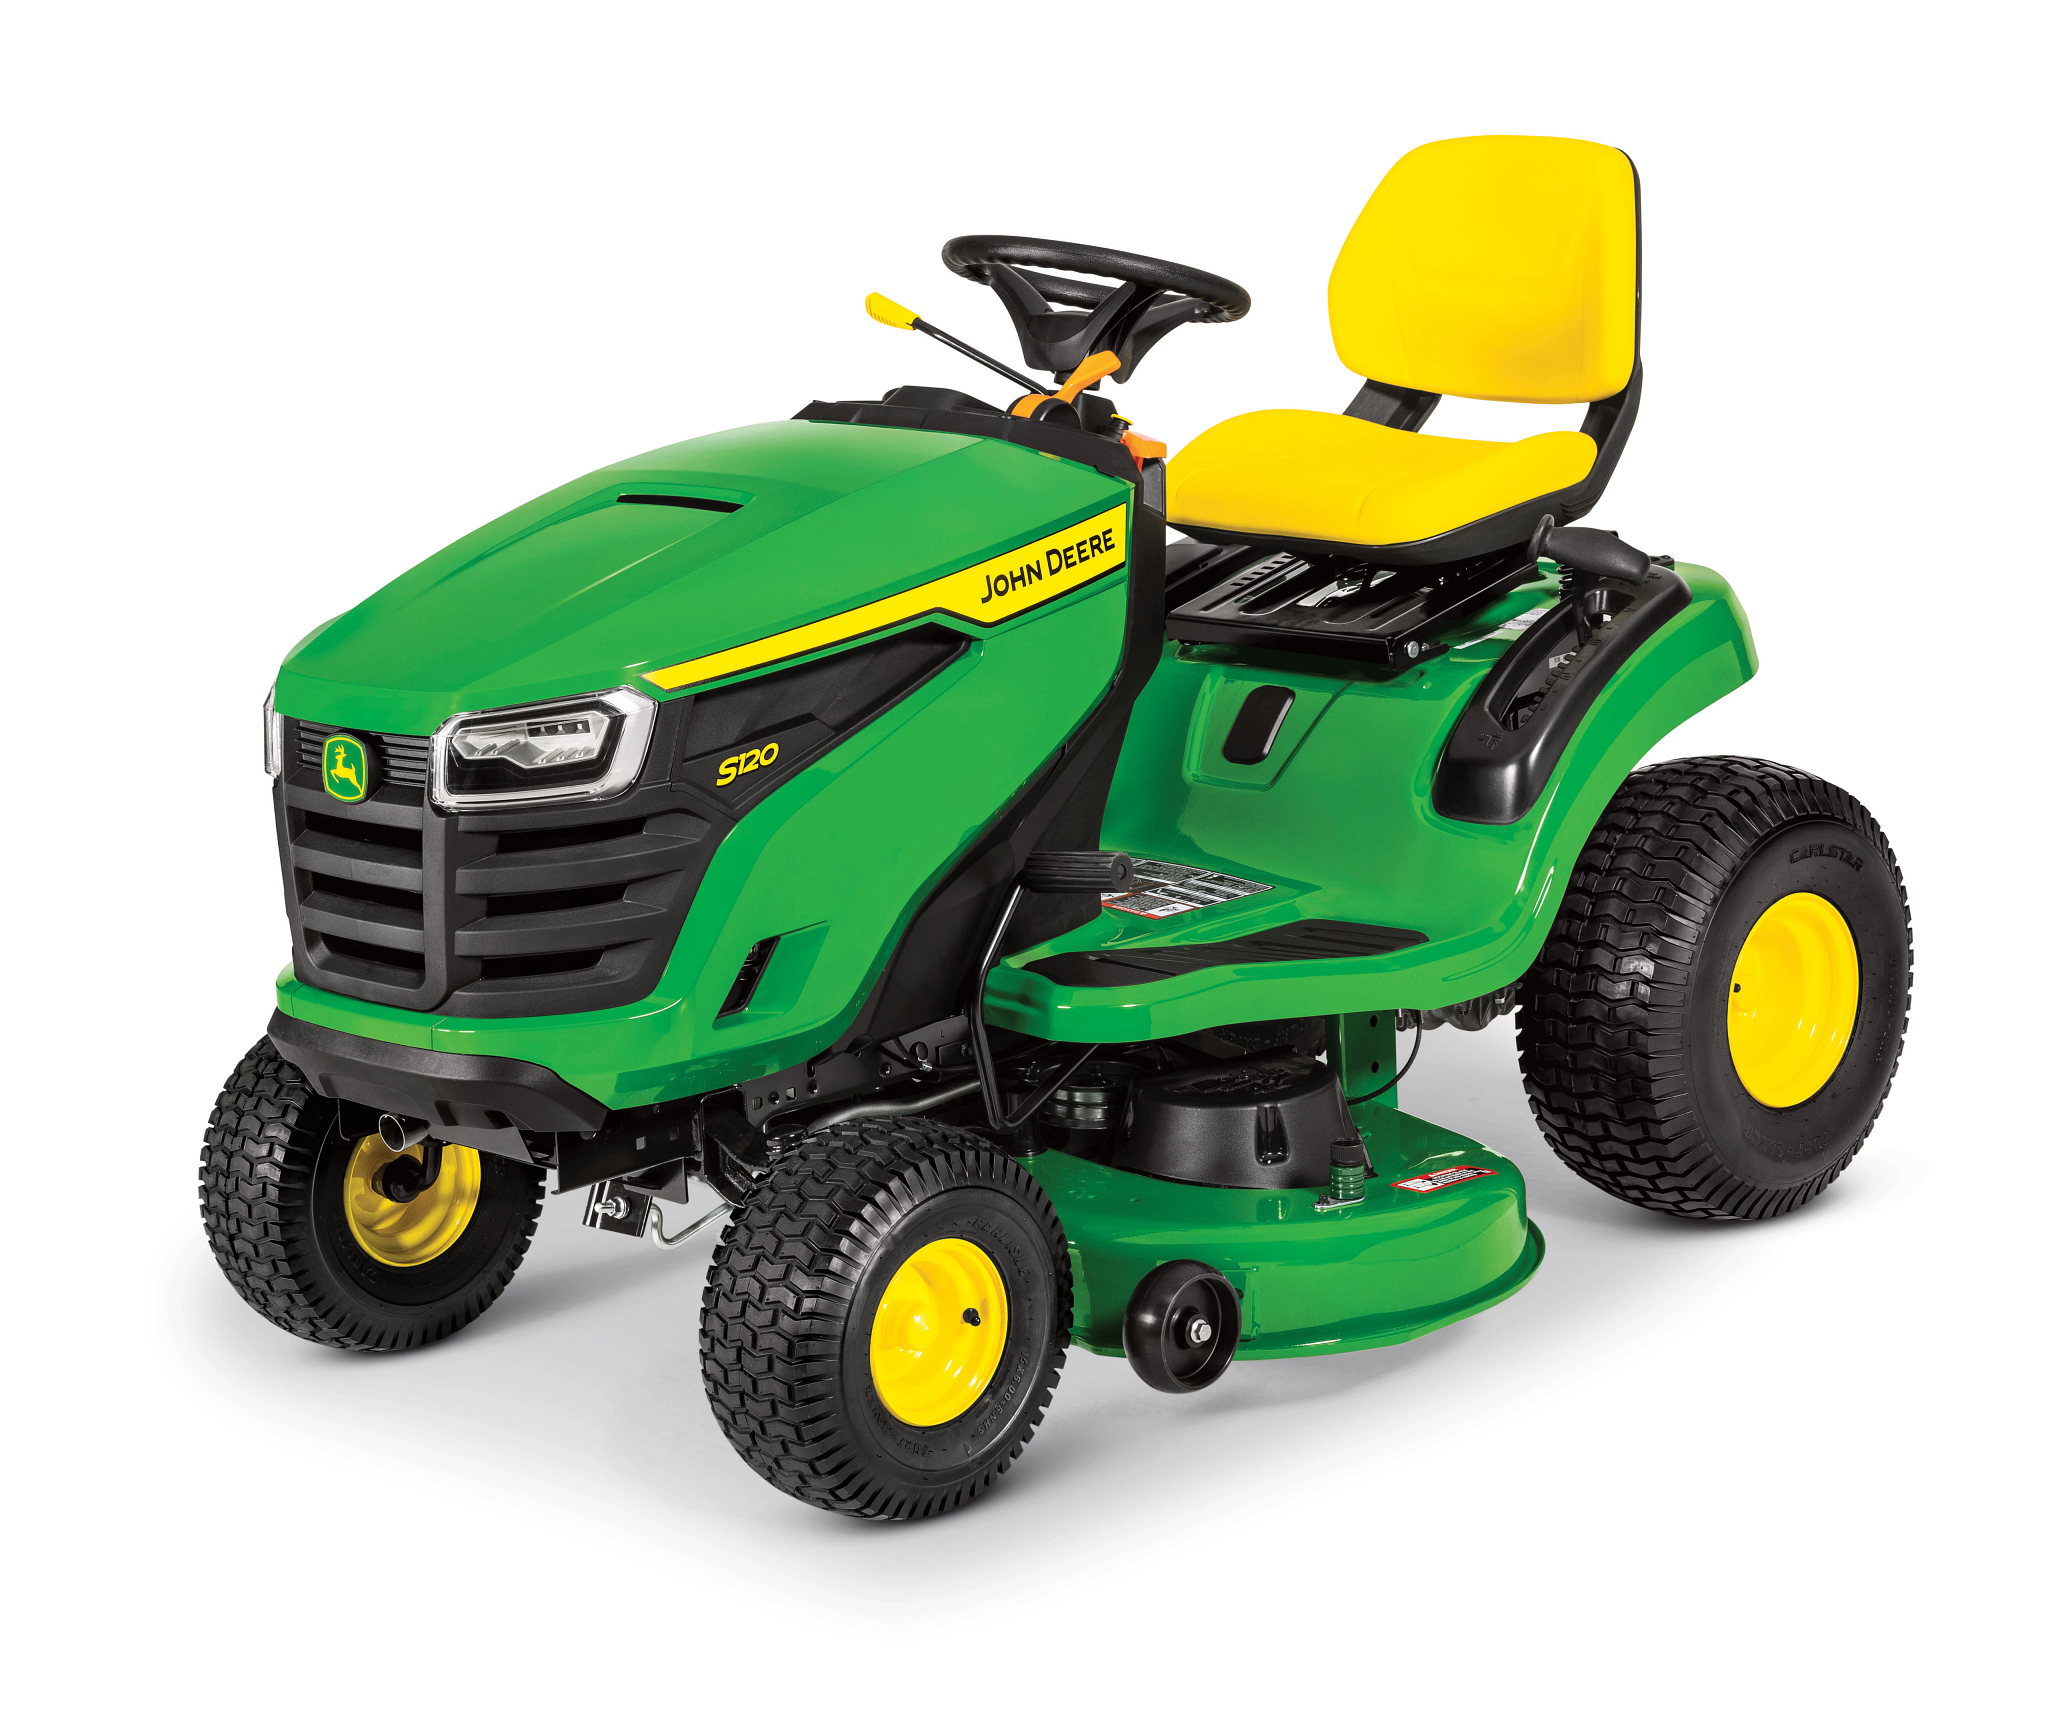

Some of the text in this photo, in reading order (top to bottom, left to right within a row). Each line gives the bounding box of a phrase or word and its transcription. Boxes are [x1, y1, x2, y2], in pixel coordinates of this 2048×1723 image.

[981, 528, 1116, 604] JOHN DEERE
[716, 742, 780, 787] S120
